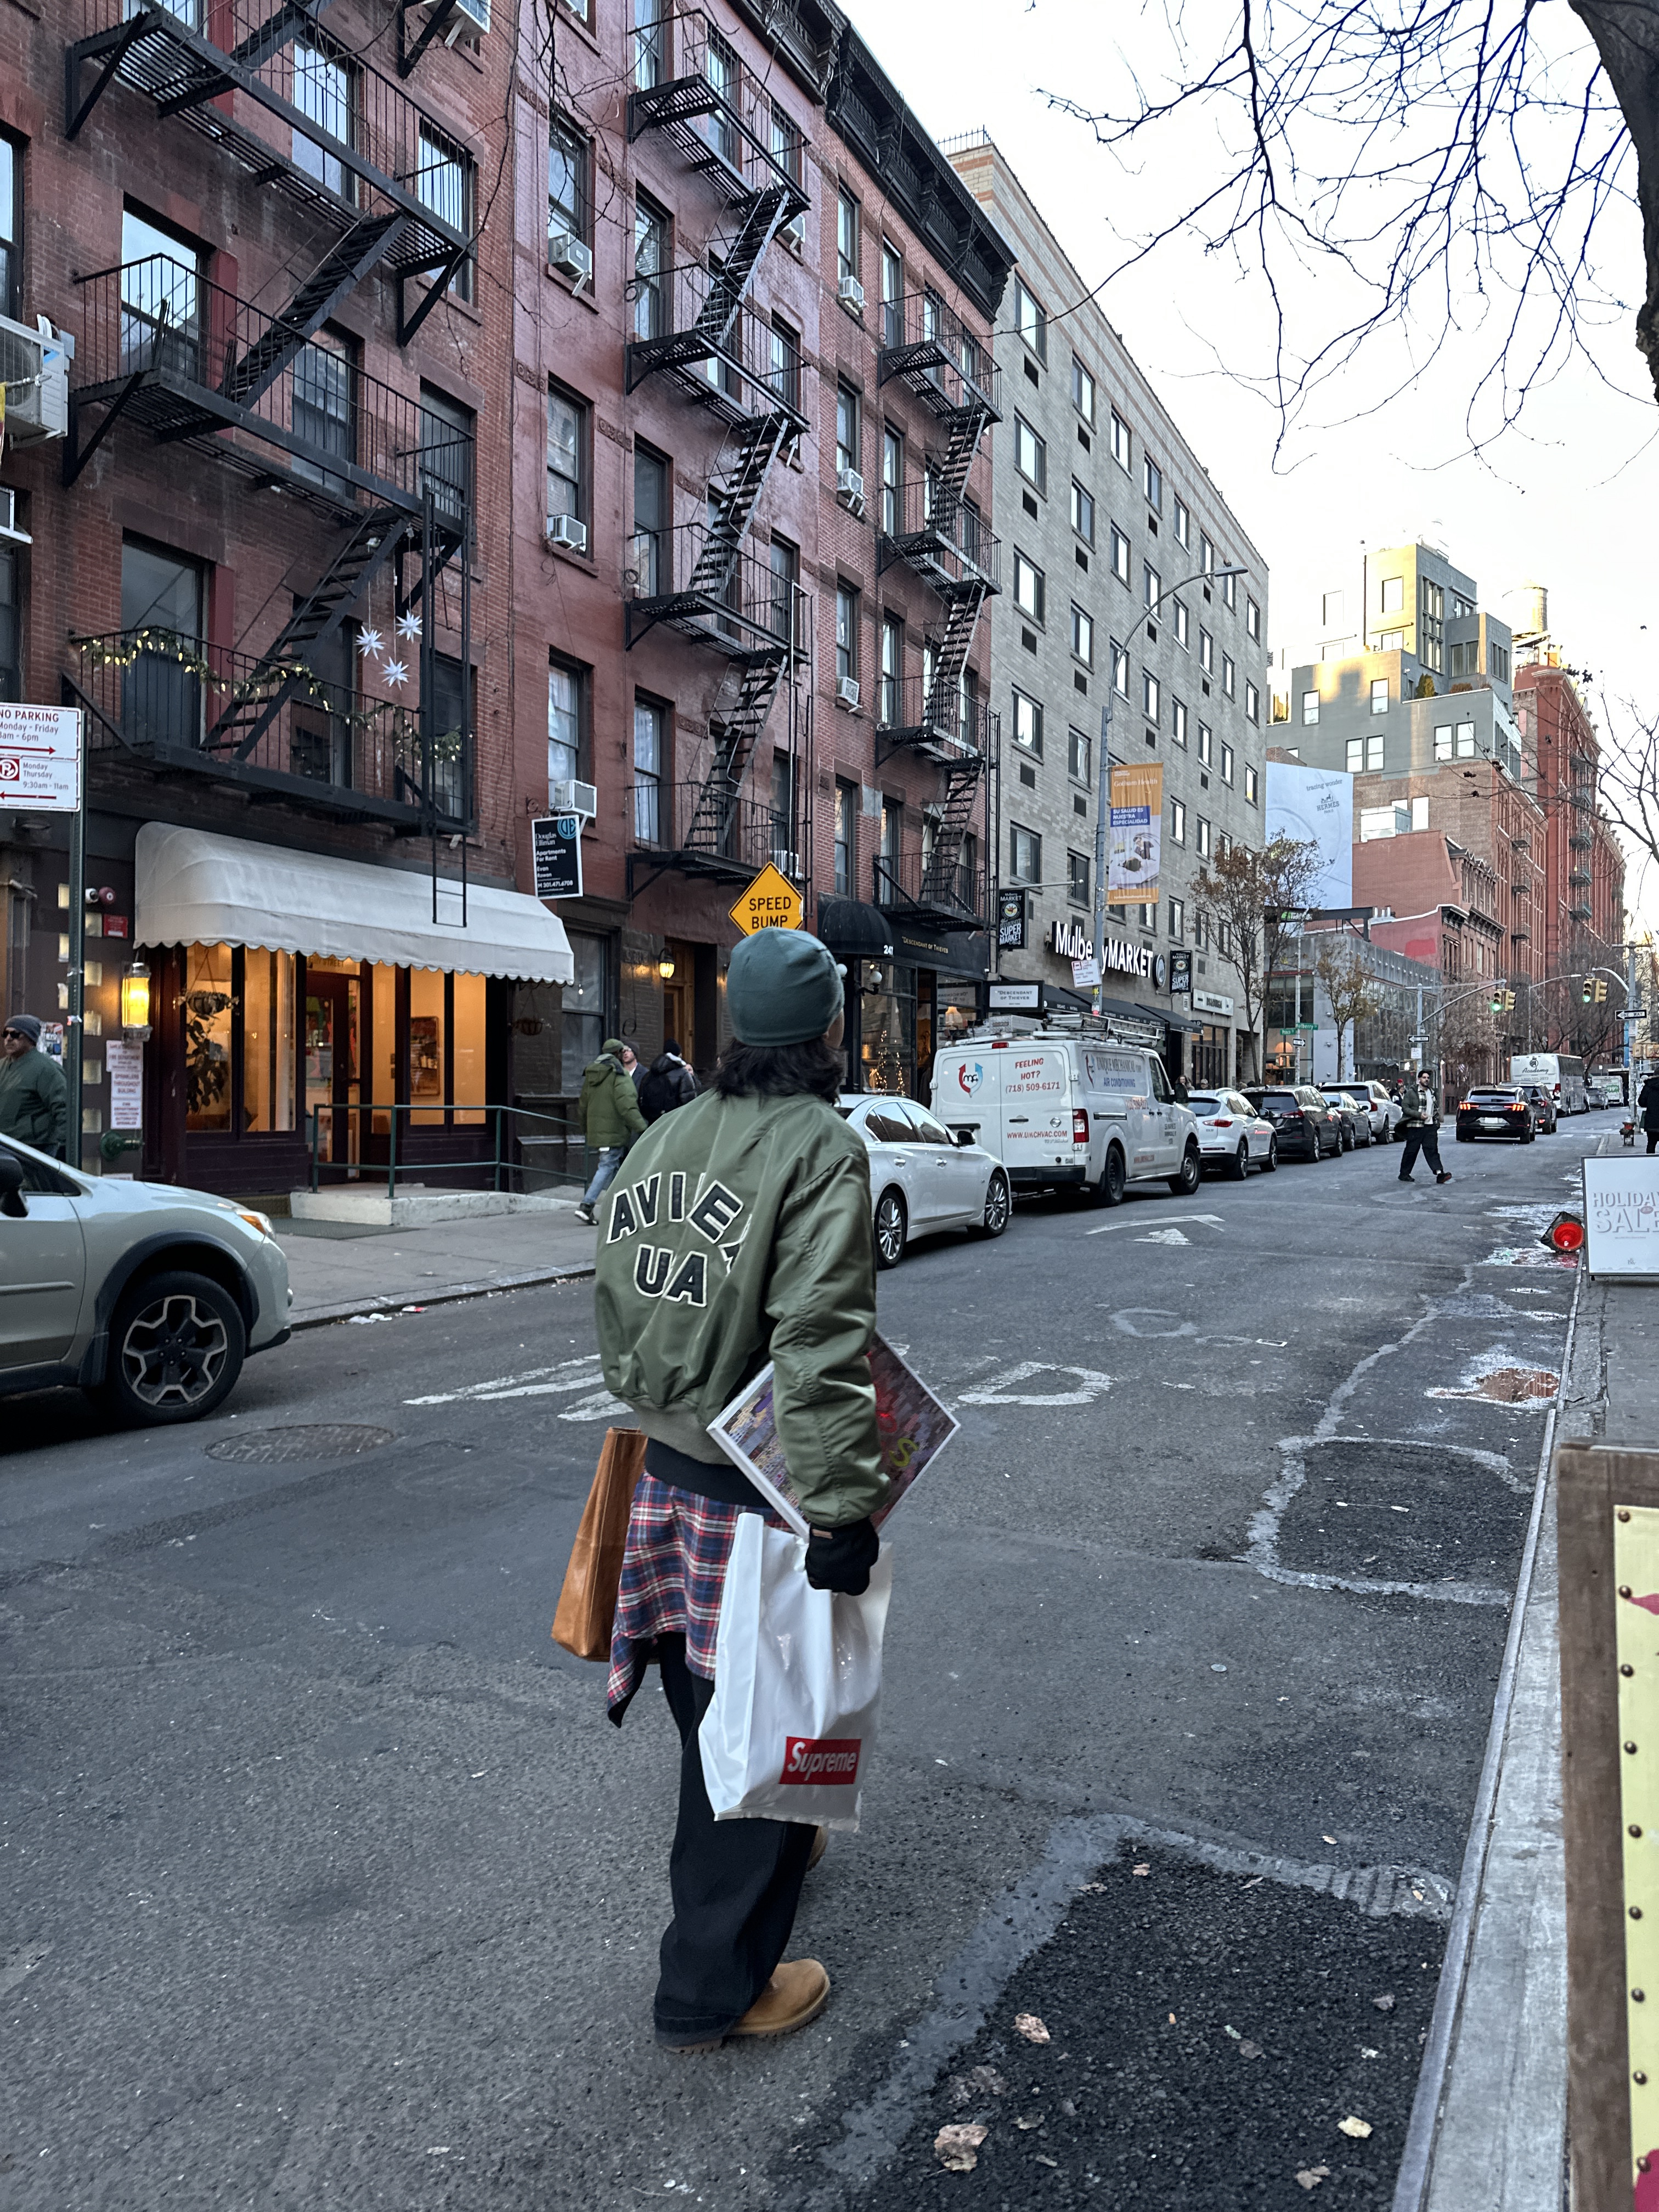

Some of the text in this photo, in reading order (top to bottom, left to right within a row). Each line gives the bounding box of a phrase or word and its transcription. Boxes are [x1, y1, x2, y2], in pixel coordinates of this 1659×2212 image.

[15, 710, 59, 723] PARKING
[35, 724, 59, 735] Friday
[22, 733, 39, 742] 6pm
[23, 763, 48, 771] Monday
[23, 770, 53, 778] Thursday
[1306, 778, 1342, 791] tracing wonder
[749, 896, 791, 911] SPEED
[752, 915, 788, 929] BUMP
[1000, 923, 1022, 938] SUPER
[999, 933, 1021, 945] MARKET
[883, 944, 894, 956] 247
[1172, 974, 1189, 985] SUPER
[1015, 1057, 1044, 1069] FEELING
[1020, 1070, 1041, 1080] HOT?
[1005, 1081, 1060, 1094] (718) 509-6171
[1110, 1077, 1136, 1087] CONDITIONING
[787, 1741, 857, 1781] Supreme
